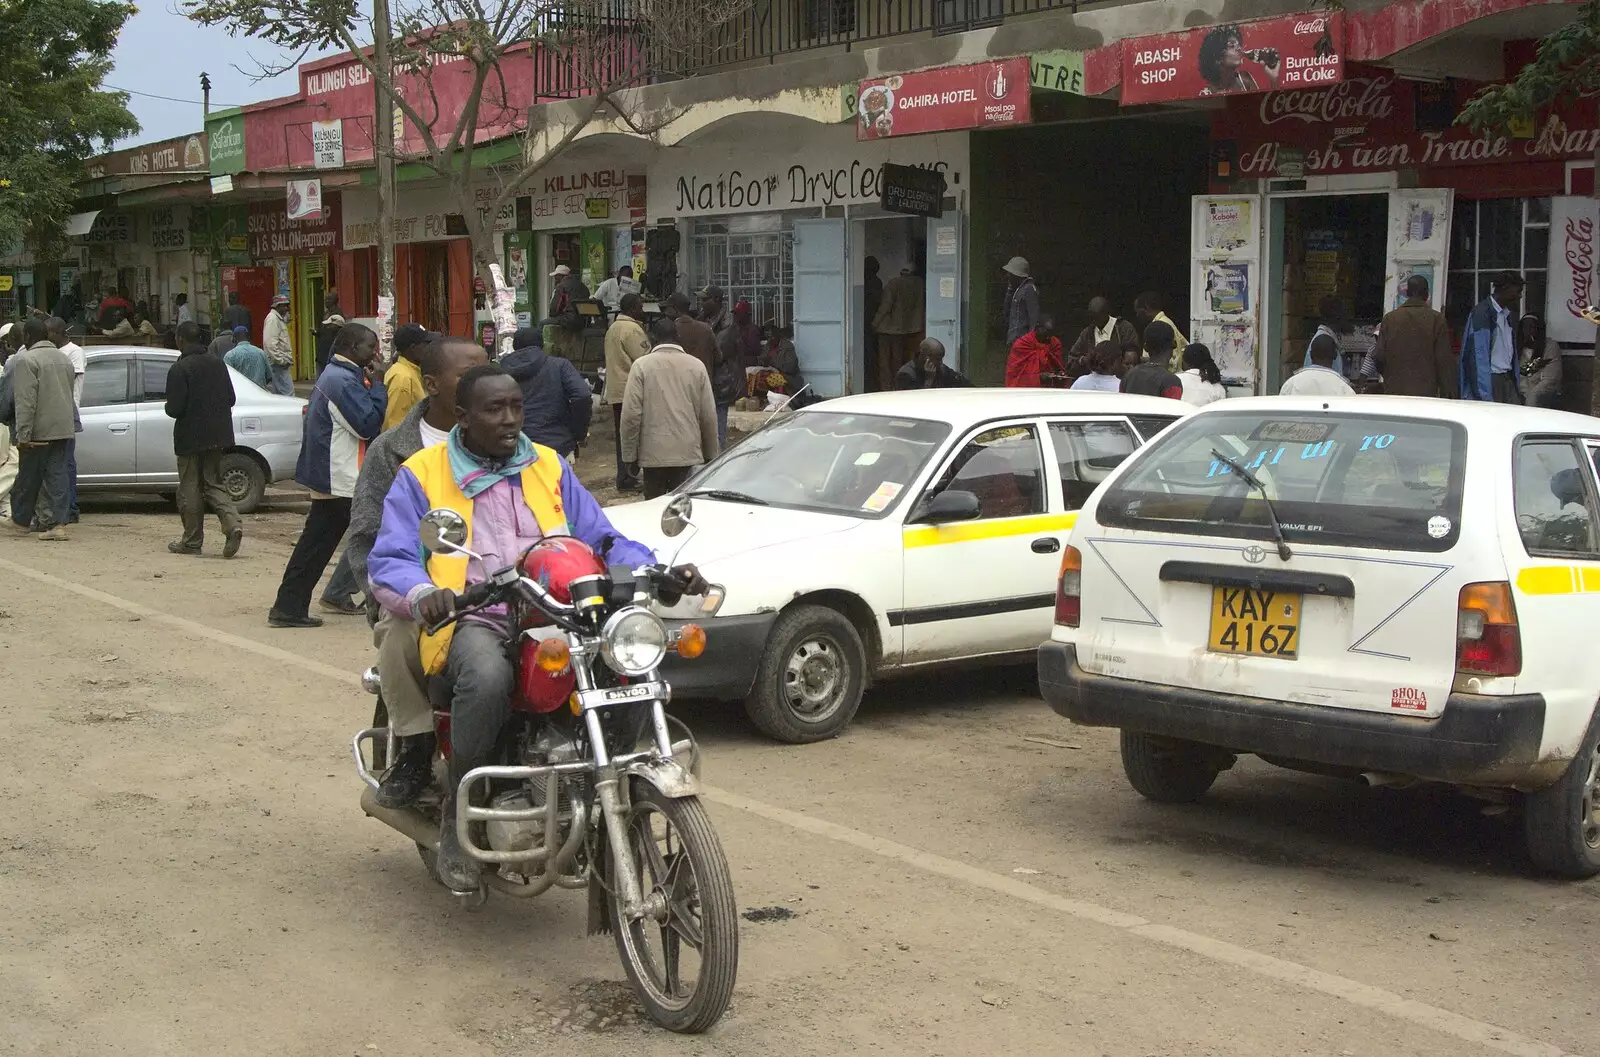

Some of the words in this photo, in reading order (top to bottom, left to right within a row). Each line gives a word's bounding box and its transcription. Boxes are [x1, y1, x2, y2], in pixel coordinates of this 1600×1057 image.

[1134, 47, 1181, 65] ABASH
[1286, 53, 1339, 70] Burudika
[307, 68, 346, 96] KILUNGU
[1030, 61, 1082, 93] NTRE
[1141, 67, 1177, 85] SHOP
[1286, 71, 1300, 83] na
[1303, 66, 1337, 83] Coke
[899, 93, 939, 110] QAHIRA
[941, 88, 978, 105] HOTEL
[984, 105, 1002, 113] Msosi
[1003, 105, 1016, 114] poa
[1259, 76, 1395, 125] Coca-Cola
[314, 128, 341, 141] KILUNGU
[152, 147, 179, 171] HOTEL
[321, 152, 335, 163] STORE
[544, 169, 625, 194] KILUNGU
[676, 170, 780, 212] Naibor
[534, 197, 558, 218] SELF
[152, 228, 185, 248] DISHES
[271, 231, 301, 252] SALON
[1566, 216, 1594, 319] Coca-Cola
[1279, 523, 1306, 531] VALVE
[1221, 587, 1275, 623] KAY
[1219, 621, 1297, 657] 416Z
[609, 688, 646, 699] SKYGO
[1392, 687, 1427, 701] BHOLA
